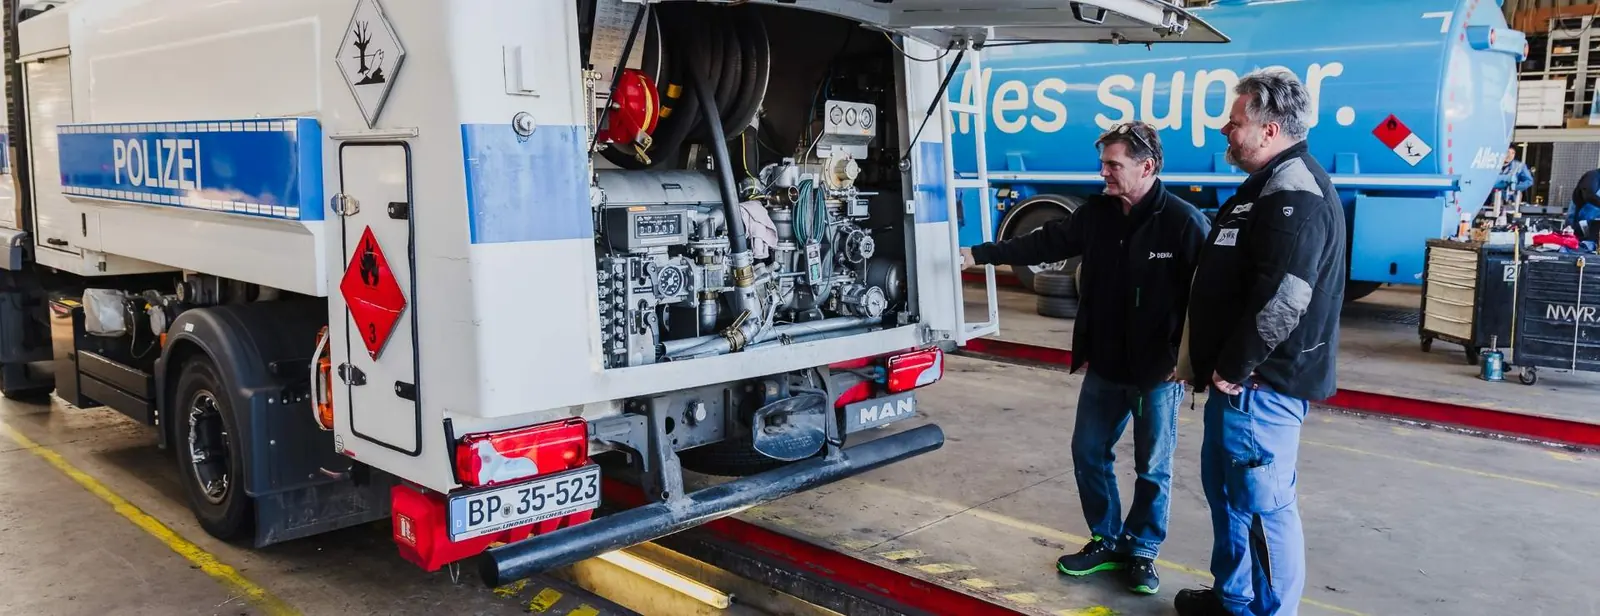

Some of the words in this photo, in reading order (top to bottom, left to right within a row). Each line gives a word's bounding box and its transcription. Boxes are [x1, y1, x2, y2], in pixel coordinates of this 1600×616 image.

[951, 67, 1067, 134] lles
[1094, 62, 1355, 148] supr.
[113, 138, 202, 190] POLIZEI
[1506, 267, 1514, 279] 2
[369, 322, 376, 344] 3
[859, 397, 914, 425] MAN
[468, 495, 501, 526] BP
[516, 473, 597, 515] 35-523
